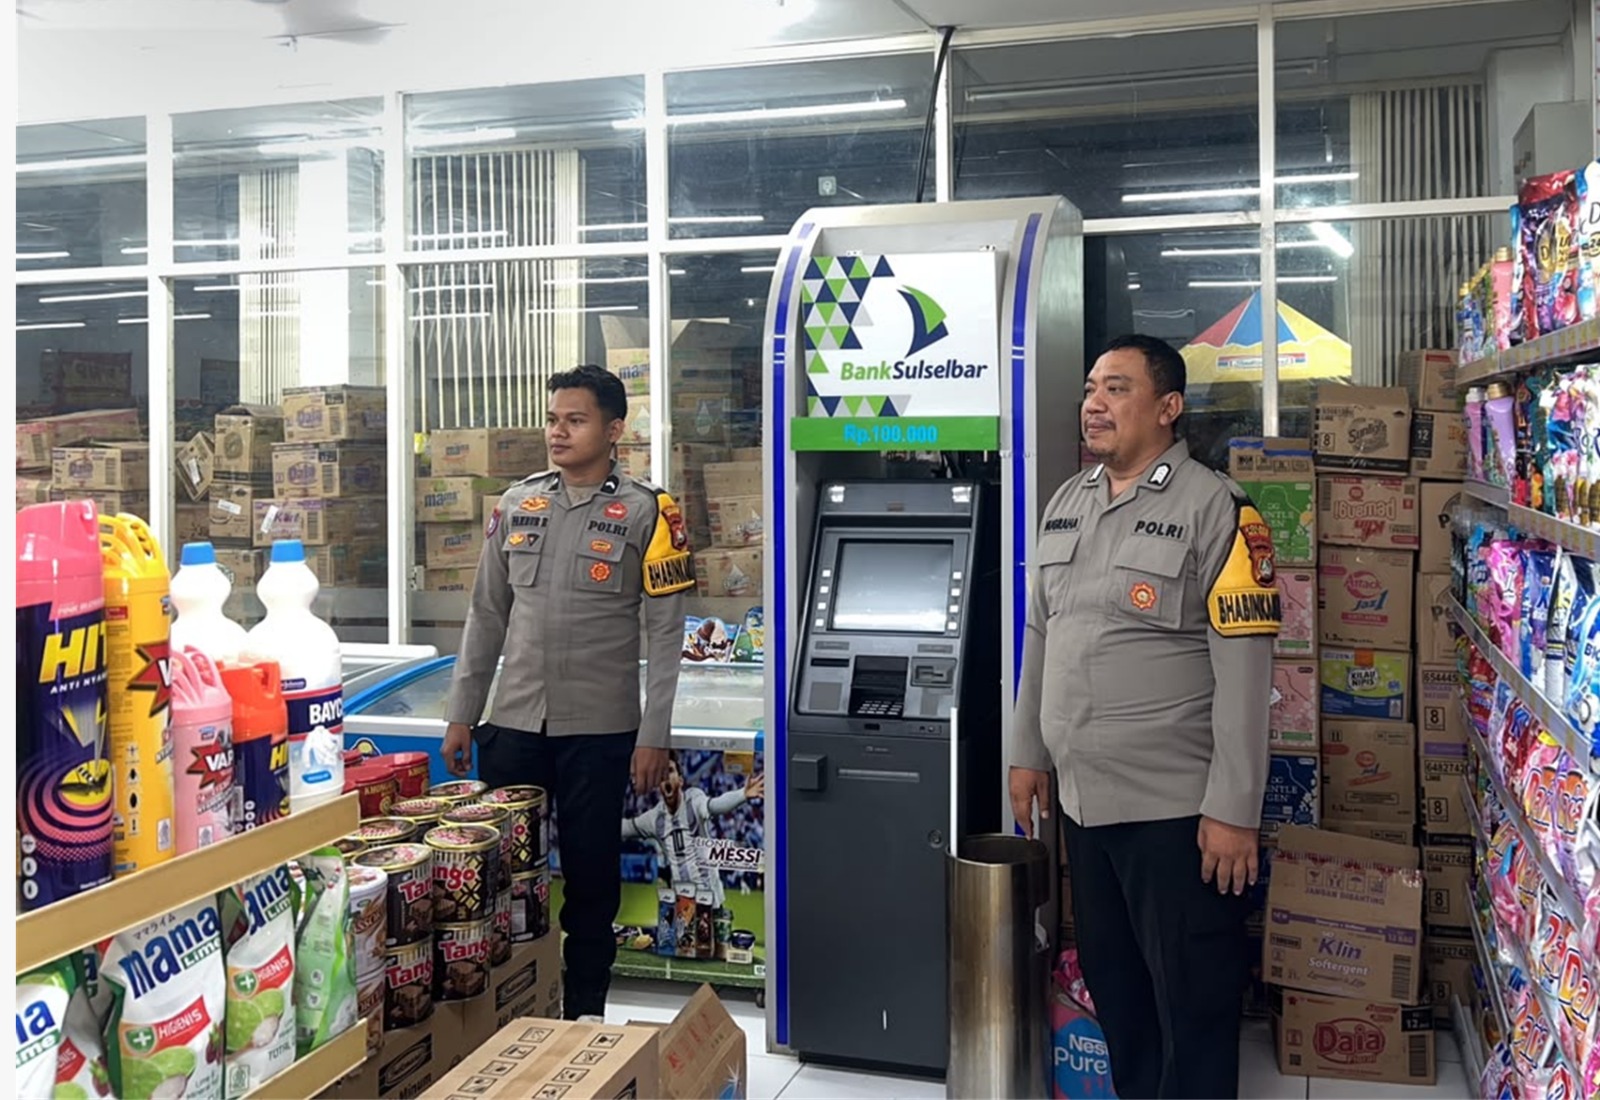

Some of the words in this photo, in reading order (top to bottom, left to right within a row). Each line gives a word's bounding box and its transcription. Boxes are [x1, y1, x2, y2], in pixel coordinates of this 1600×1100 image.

[840, 359, 988, 381] BankSulselbar
[843, 424, 938, 446] Rp.100.000
[1322, 433, 1331, 447] 8
[587, 520, 628, 537] POLRI
[1134, 520, 1184, 539] POLRI
[1430, 710, 1438, 725] 8
[1433, 800, 1442, 815] 8
[709, 847, 761, 864] MESSI
[1434, 892, 1443, 906] 8
[158, 1008, 203, 1040] HIGENIS
[1317, 1024, 1382, 1055] Daia
[1054, 1046, 1108, 1075] Pure
